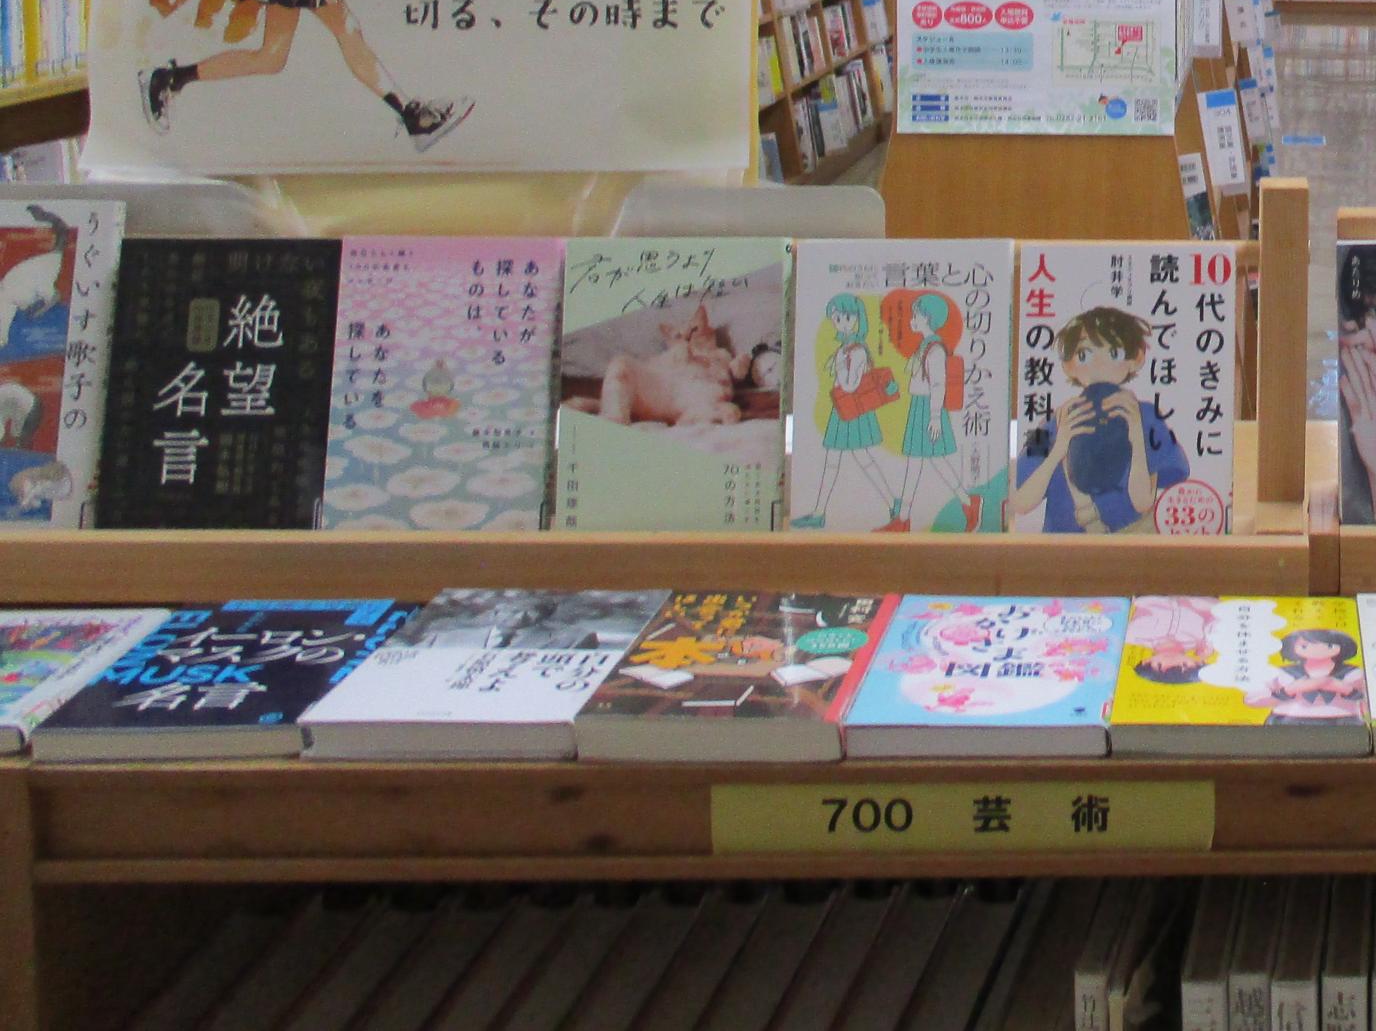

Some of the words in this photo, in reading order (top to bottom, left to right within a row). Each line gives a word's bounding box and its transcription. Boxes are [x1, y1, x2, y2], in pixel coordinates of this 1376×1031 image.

[221, 293, 284, 416] 絶望
[492, 259, 514, 365] 探している
[520, 260, 539, 345] あなたが
[1023, 253, 1056, 457] 人生の教科書
[1149, 254, 1180, 450] 読んでほしい
[1189, 253, 1232, 457] 10代のきみに
[344, 322, 365, 429] 探している
[372, 322, 390, 409] あなたを
[153, 361, 209, 485] 名言
[1164, 506, 1215, 525] 33の
[103, 664, 264, 685] MUSK
[113, 682, 268, 711] 名言
[821, 797, 914, 834] 700
[973, 796, 1110, 833] 芸術
